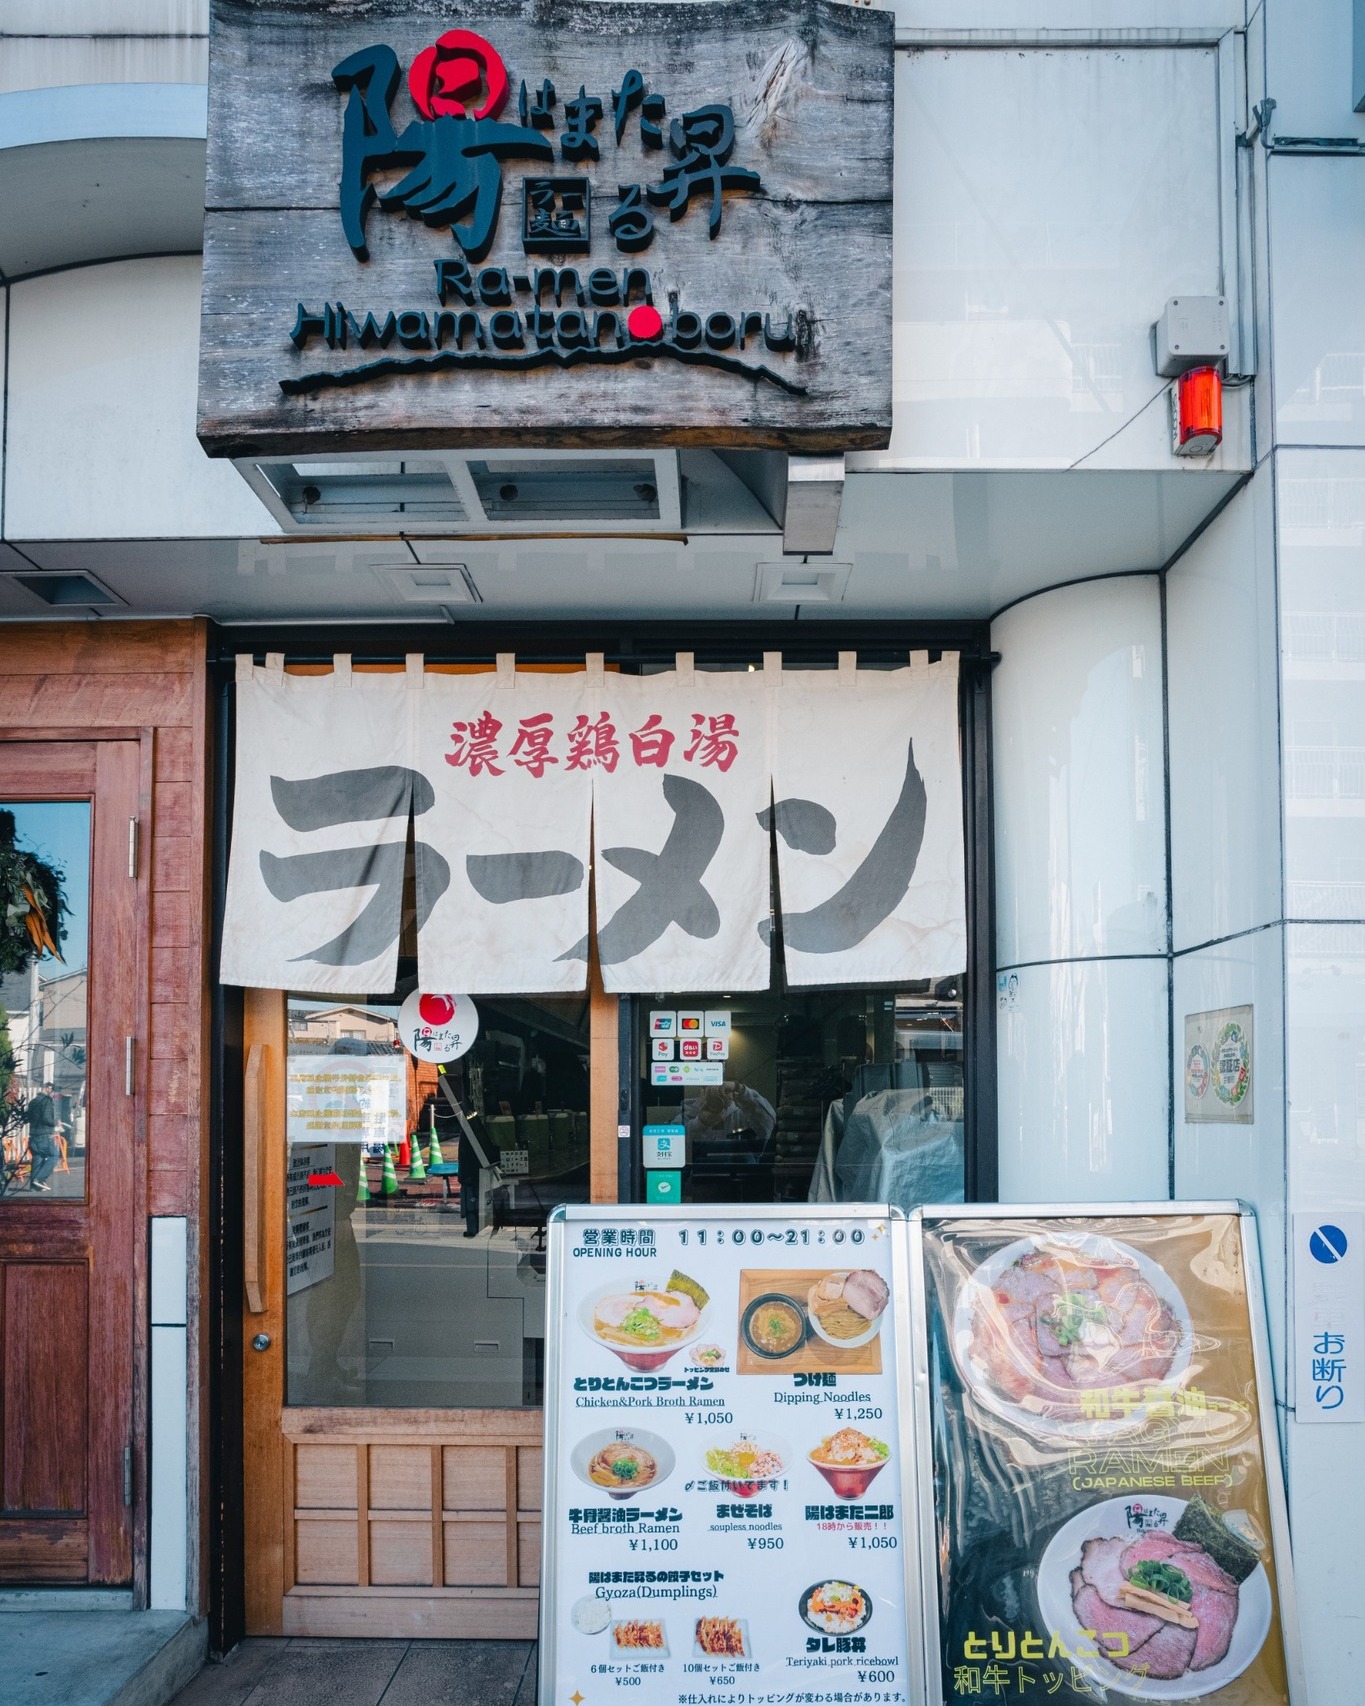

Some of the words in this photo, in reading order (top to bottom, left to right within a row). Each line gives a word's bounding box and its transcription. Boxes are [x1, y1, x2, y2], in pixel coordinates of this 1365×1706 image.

[433, 258, 654, 306] Ra-men
[444, 710, 741, 778] 濃厚鶏白湯
[259, 736, 928, 967] ラーメン
[583, 1228, 656, 1246] 営業時間
[572, 1247, 622, 1257] OPENING
[625, 1247, 657, 1257] HOUR
[573, 1376, 714, 1391] とりとんこつラーメン
[793, 1372, 837, 1387] つけ麺
[575, 1396, 652, 1407] Chicken&Pork
[656, 1396, 687, 1407] Broth
[689, 1396, 725, 1407] Ramen
[774, 1391, 821, 1405] Dipping
[823, 1391, 872, 1403] Noodles
[685, 1412, 734, 1425] ¥1,050
[834, 1407, 883, 1421] ¥1,250
[1068, 1445, 1230, 1475] RAMEN
[1072, 1475, 1176, 1491] (JAPANESE
[1181, 1474, 1233, 1488] BEEF)
[568, 1507, 683, 1523] 牛骨醤油ラーメン
[716, 1503, 773, 1518] まぜそば
[805, 1505, 894, 1521] 陽はまた二郎
[571, 1523, 600, 1534] Beef
[602, 1522, 635, 1534] broth
[638, 1522, 680, 1533] Ramen
[709, 1523, 747, 1532] soupless
[749, 1522, 783, 1531] noodles
[629, 1539, 678, 1552] ¥1,100
[747, 1537, 784, 1550] ¥950
[848, 1536, 898, 1550] ¥1,050
[595, 1585, 718, 1601] Gyoza(Dumplings)
[806, 1637, 867, 1653] タレ豚丼
[786, 1657, 828, 1668] Teriyaki
[830, 1657, 853, 1668] pork
[856, 1656, 900, 1666] ricebowl
[615, 1677, 641, 1686] ¥500
[709, 1676, 735, 1685] ¥650
[857, 1670, 895, 1683] ¥600
